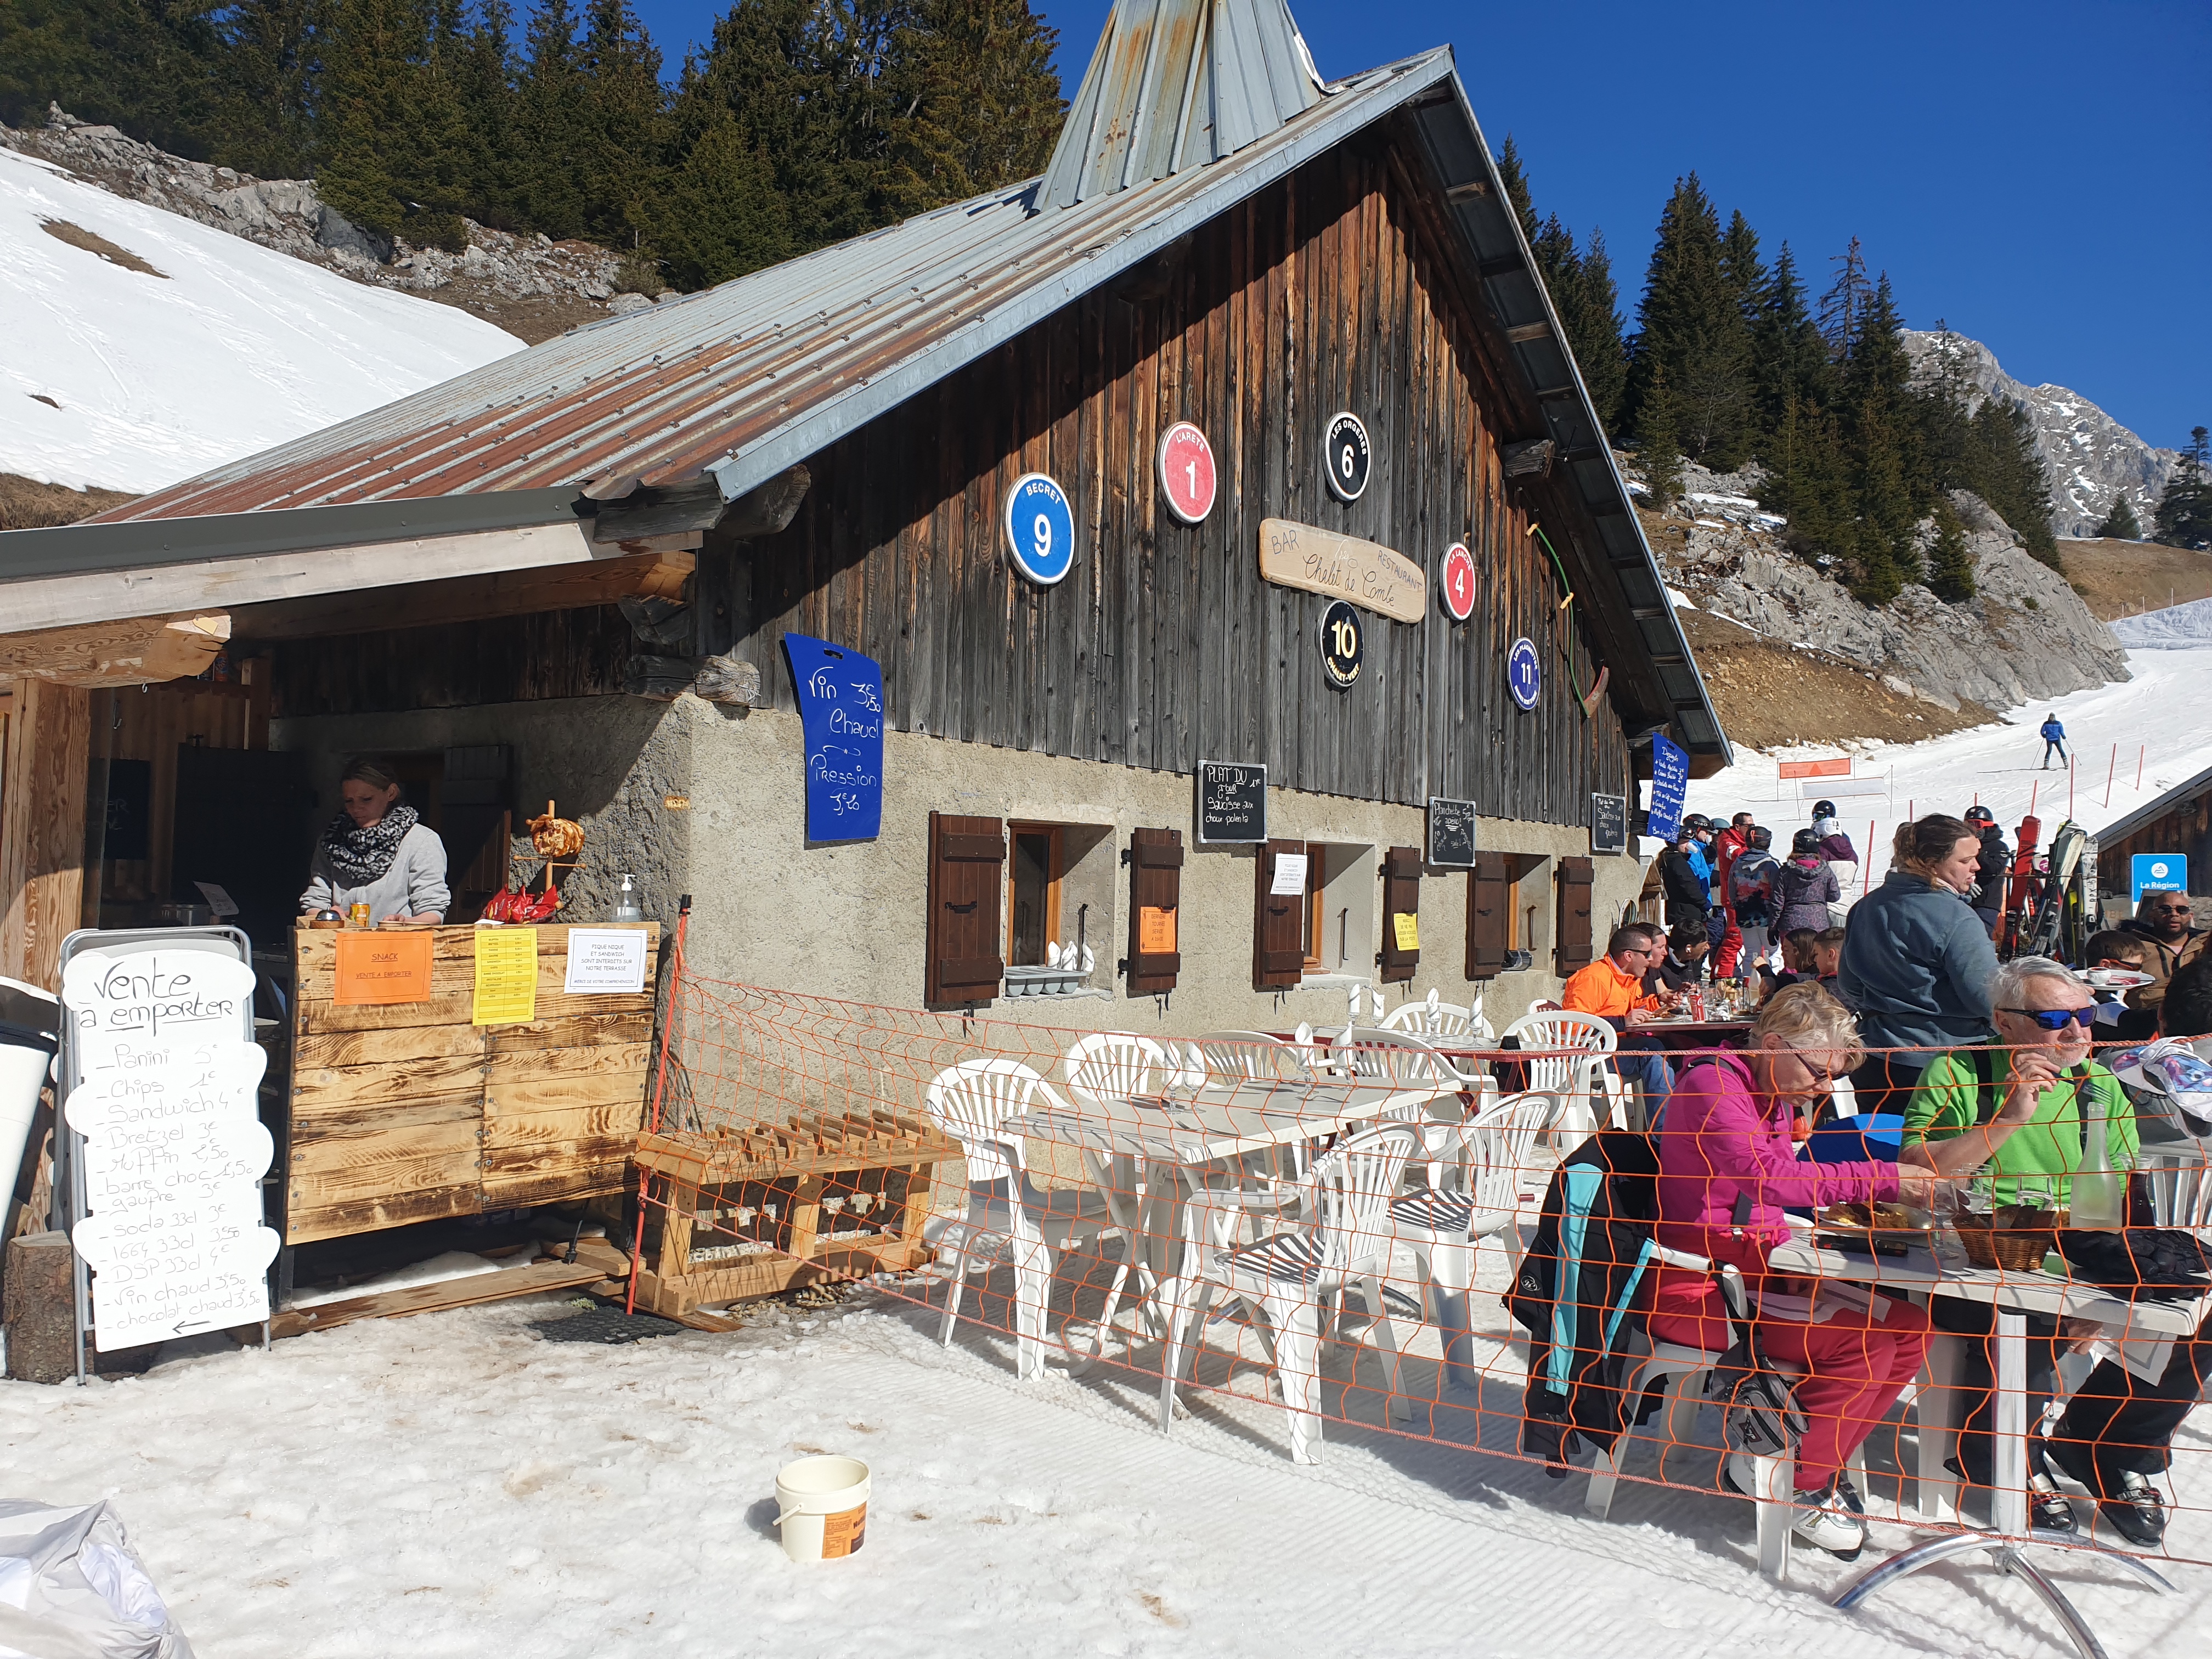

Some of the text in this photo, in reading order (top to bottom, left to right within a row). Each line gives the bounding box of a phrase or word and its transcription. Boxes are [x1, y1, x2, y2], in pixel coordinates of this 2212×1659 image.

[1176, 431, 1205, 453] L'ARETE
[1331, 420, 1367, 455] LES ORGERES
[1341, 444, 1355, 478] 6
[1186, 460, 1195, 499] 1
[1026, 482, 1062, 505] BECRET
[1034, 514, 1052, 557] 9
[1271, 529, 1299, 555] BAR
[1302, 554, 1341, 586] Chalet
[1377, 550, 1422, 592] RESTAURANT
[1455, 568, 1464, 599] 4
[1331, 620, 1356, 659] 10
[809, 667, 837, 699] Vin
[1521, 663, 1531, 685] 11
[830, 708, 879, 738] Chaud
[1207, 765, 1248, 783] PLAT DU
[1207, 796, 1241, 811] Saucisse
[2151, 881, 2180, 890] Région
[371, 952, 398, 961] SNACK
[94, 957, 191, 1000] Vente
[115, 1043, 170, 1069] Panini
[111, 1079, 165, 1103] Chips
[108, 1091, 214, 1124] Sandwich
[164, 1170, 212, 1187] choc
[114, 1214, 164, 1237] soda
[154, 1276, 211, 1301] chaud
[189, 1291, 233, 1315] chaud
